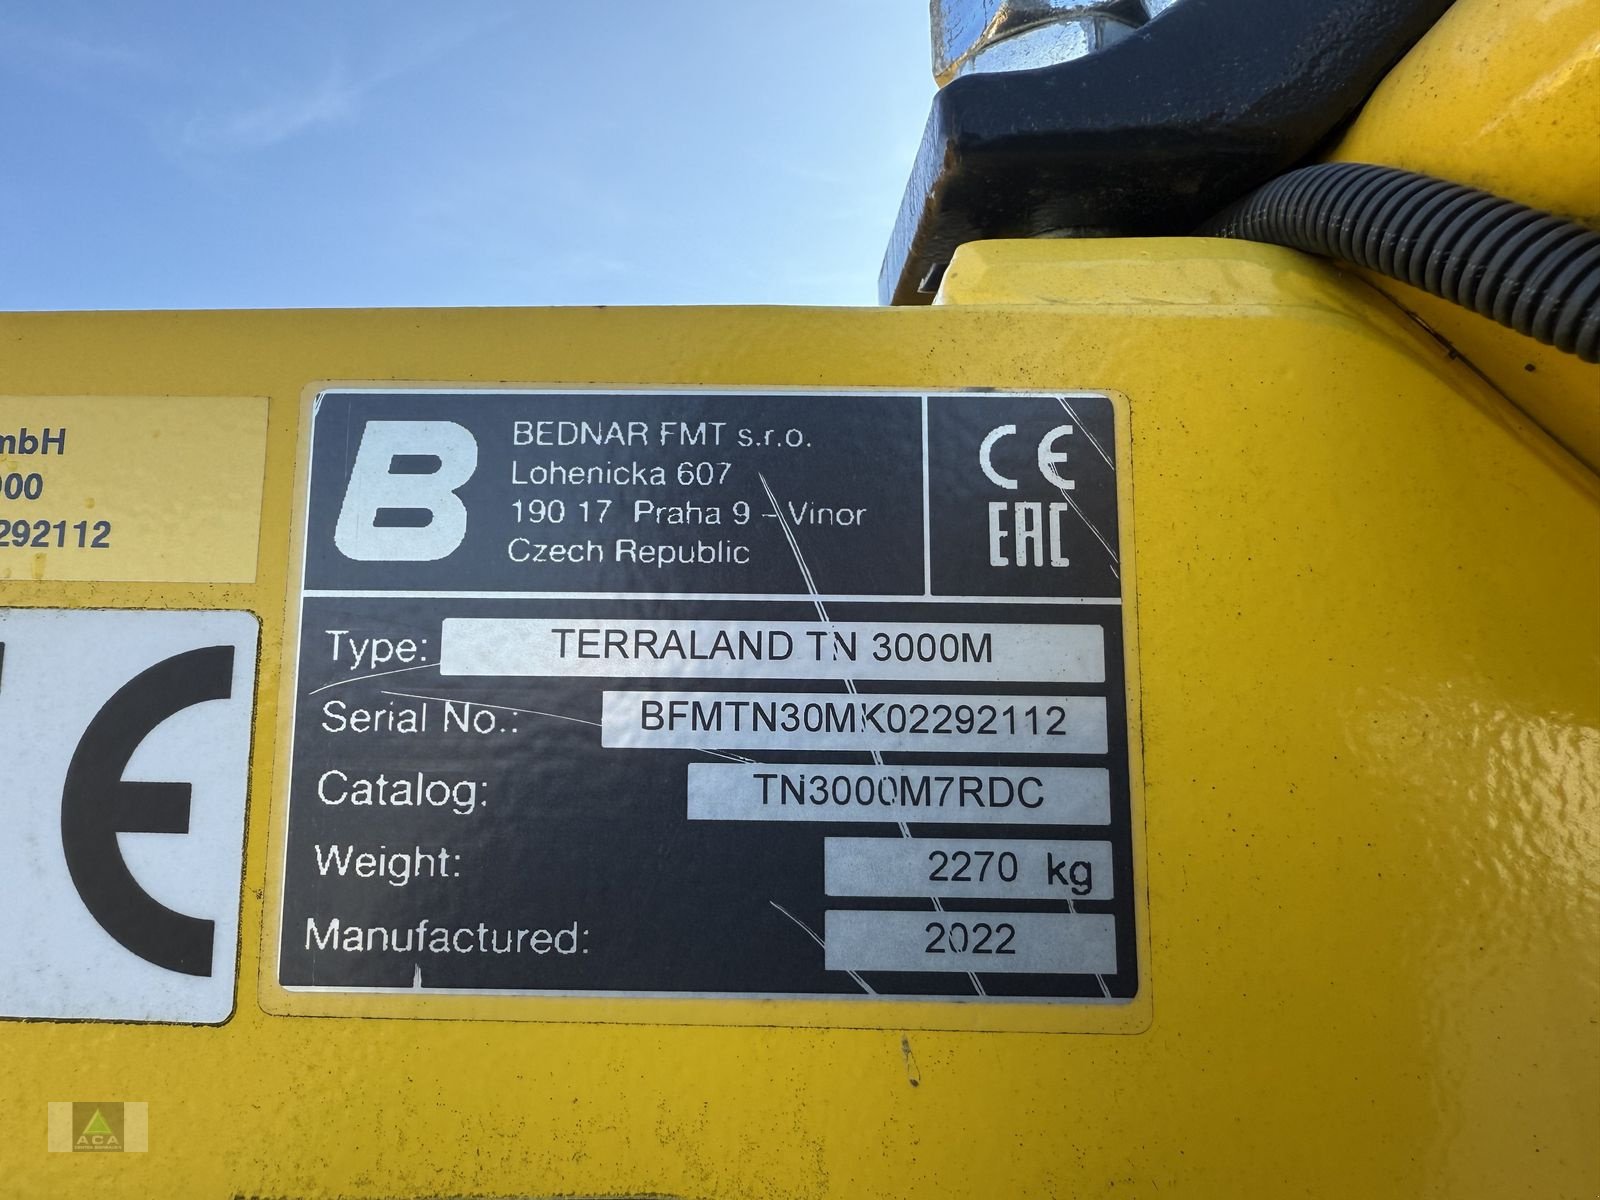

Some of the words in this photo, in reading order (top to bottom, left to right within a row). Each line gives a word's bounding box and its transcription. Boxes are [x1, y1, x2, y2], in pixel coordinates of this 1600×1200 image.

[513, 421, 649, 446] BEDNAR
[660, 422, 727, 446] FMT
[737, 427, 812, 447] s.r.o.
[0, 473, 43, 500] 00
[511, 461, 666, 486] Lohenicka
[676, 462, 732, 486] 607
[512, 499, 566, 523] 190
[578, 500, 612, 523] 17
[633, 500, 721, 525] Praha
[732, 501, 751, 525] 9
[788, 501, 867, 526] Vinor
[508, 538, 603, 563] Czech
[615, 539, 750, 569] Republic
[325, 630, 428, 670] Type:
[551, 628, 793, 662] TERRALAND
[806, 631, 857, 662] TN
[872, 632, 993, 663] 3000M
[321, 700, 426, 734] Serial
[443, 701, 518, 734] No.:
[640, 700, 1066, 736] BFMTN30MK02292112
[0, 642, 235, 978] E
[317, 769, 488, 815] Catalog:
[753, 773, 1045, 809] TN3000M7RDC
[314, 844, 461, 887] Weight:
[928, 850, 1018, 883] 2270
[1047, 852, 1093, 895] kg
[305, 917, 589, 955] Manufactured:
[924, 921, 1016, 956] 2022
